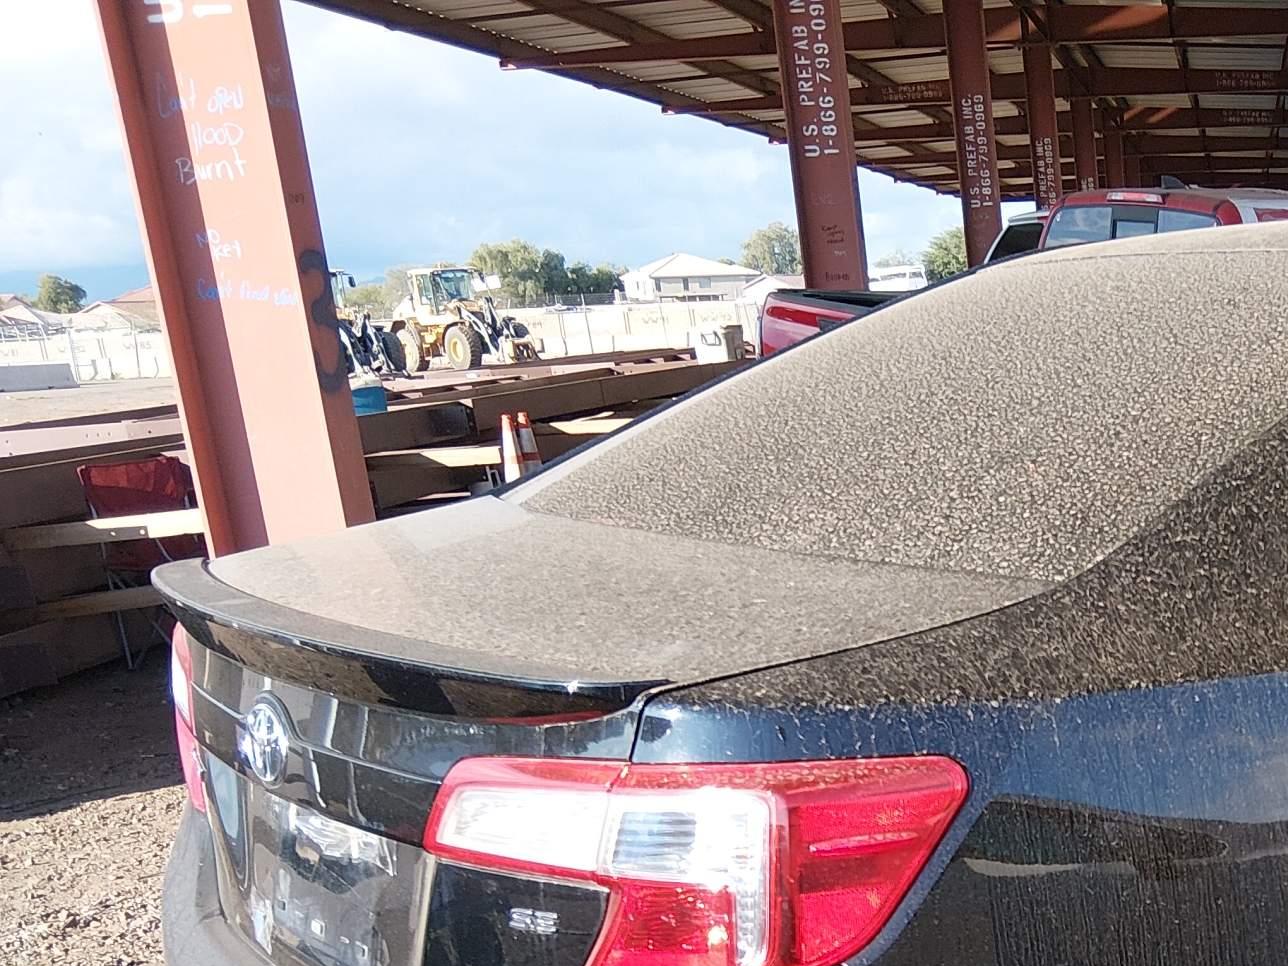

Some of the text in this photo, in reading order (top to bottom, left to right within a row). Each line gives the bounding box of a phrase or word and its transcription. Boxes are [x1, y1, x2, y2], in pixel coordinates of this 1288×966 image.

[792, 25, 815, 106] PREFAB
[809, 0, 840, 155] 1-866-799-09
[803, 119, 821, 157] U.S.
[962, 93, 981, 208] U.S. PREFAB INC.
[974, 95, 994, 207] 1-866-799-0969
[1037, 160, 1048, 197] PREFAB
[508, 908, 558, 935] SE
